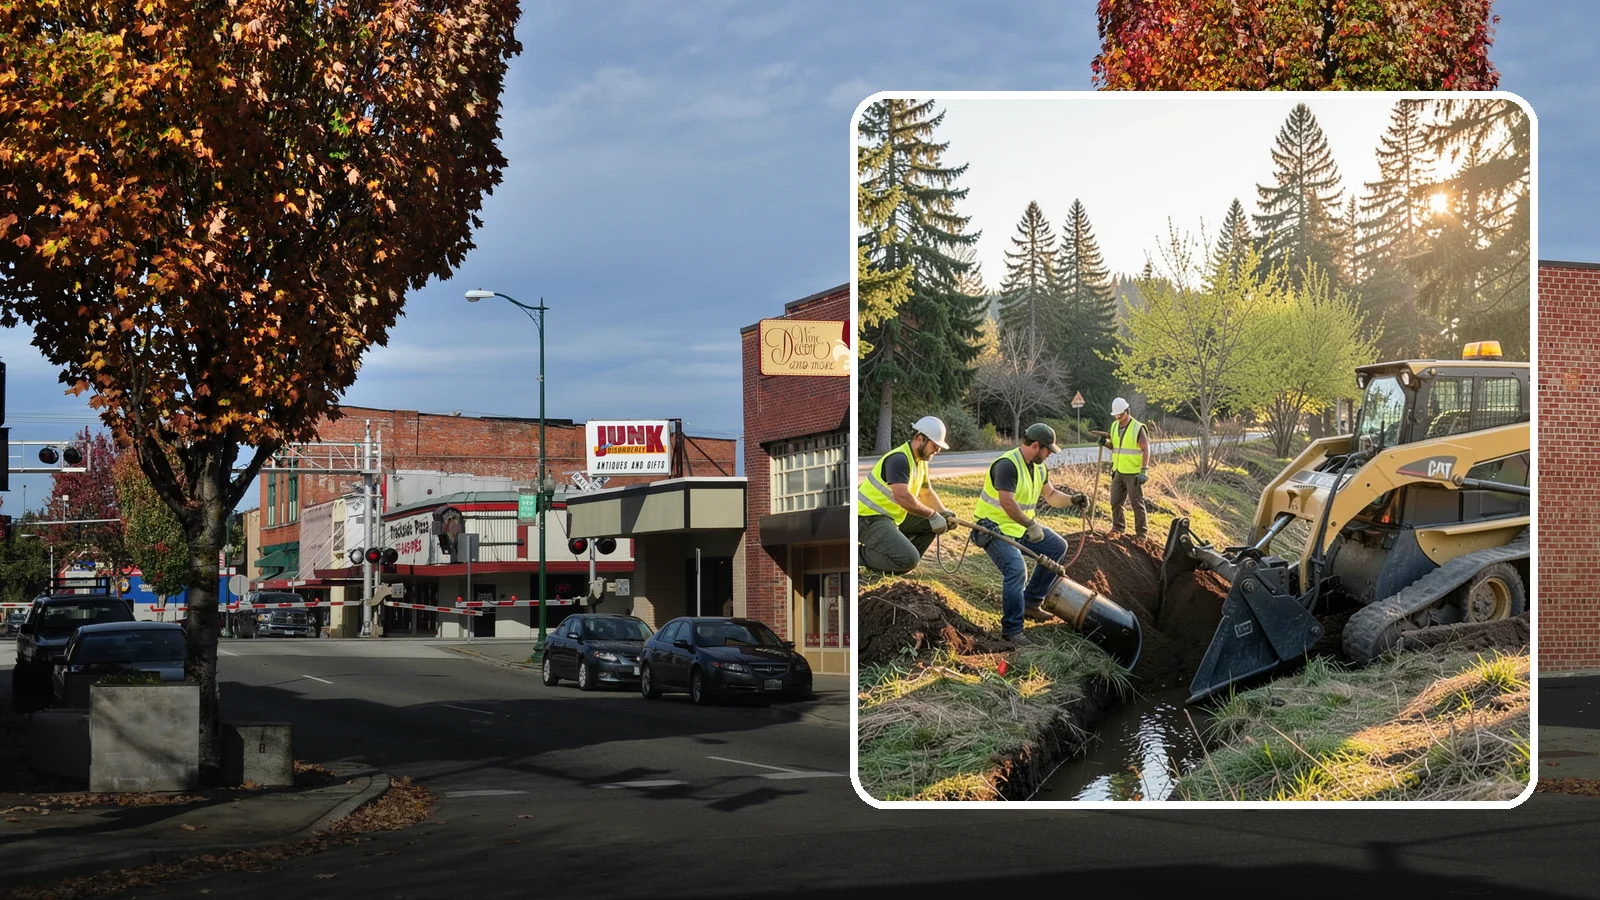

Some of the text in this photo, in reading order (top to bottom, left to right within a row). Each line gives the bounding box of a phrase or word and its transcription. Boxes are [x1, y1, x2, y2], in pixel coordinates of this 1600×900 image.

[595, 425, 665, 457] JUNK
[607, 446, 646, 454] DISORDERLY
[597, 460, 666, 470] ANTIQUES AND GIFTS
[1428, 460, 1452, 480] CAT
[414, 519, 429, 535] Pizza
